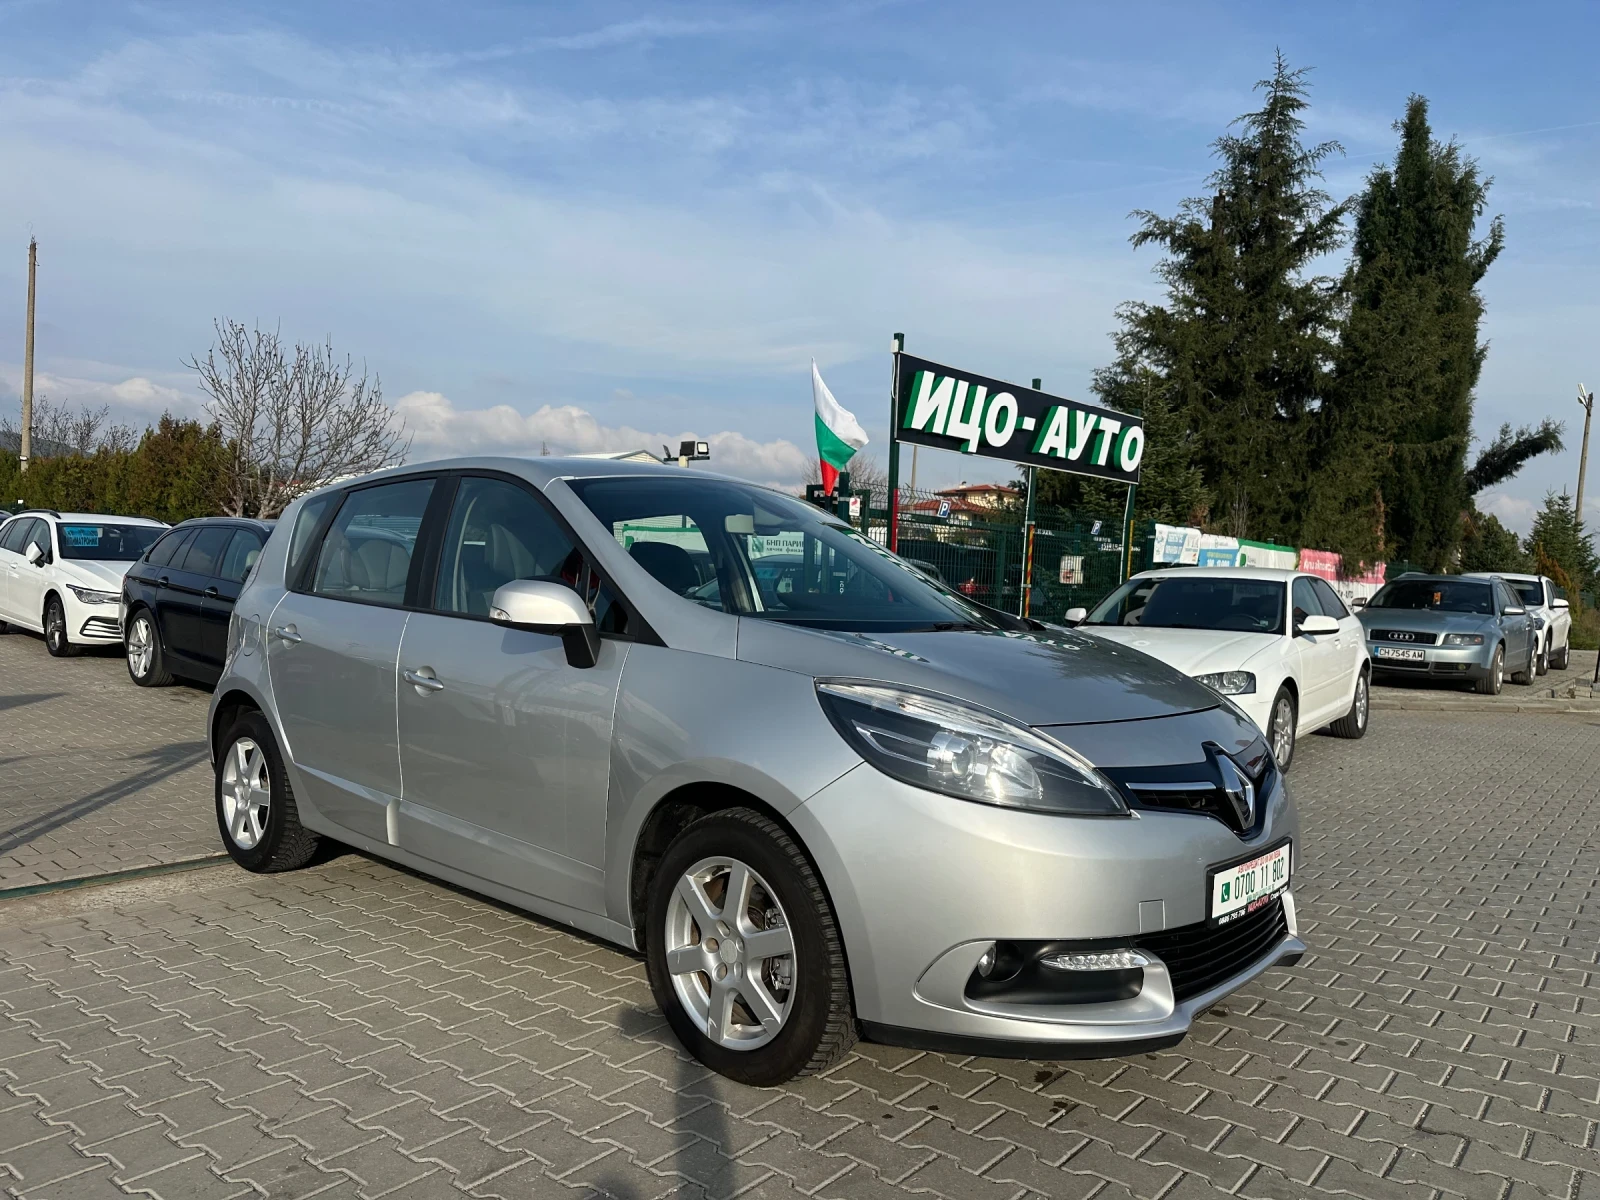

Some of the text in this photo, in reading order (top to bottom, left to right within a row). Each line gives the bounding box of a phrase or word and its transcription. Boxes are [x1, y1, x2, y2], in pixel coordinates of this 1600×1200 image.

[905, 370, 1145, 472] ИЦО-АУТО
[766, 539, 780, 547] БНП
[1391, 649, 1410, 658] 7545
[1234, 870, 1255, 900] 0700
[1260, 864, 1268, 888] 11
[1272, 856, 1284, 883] 802
